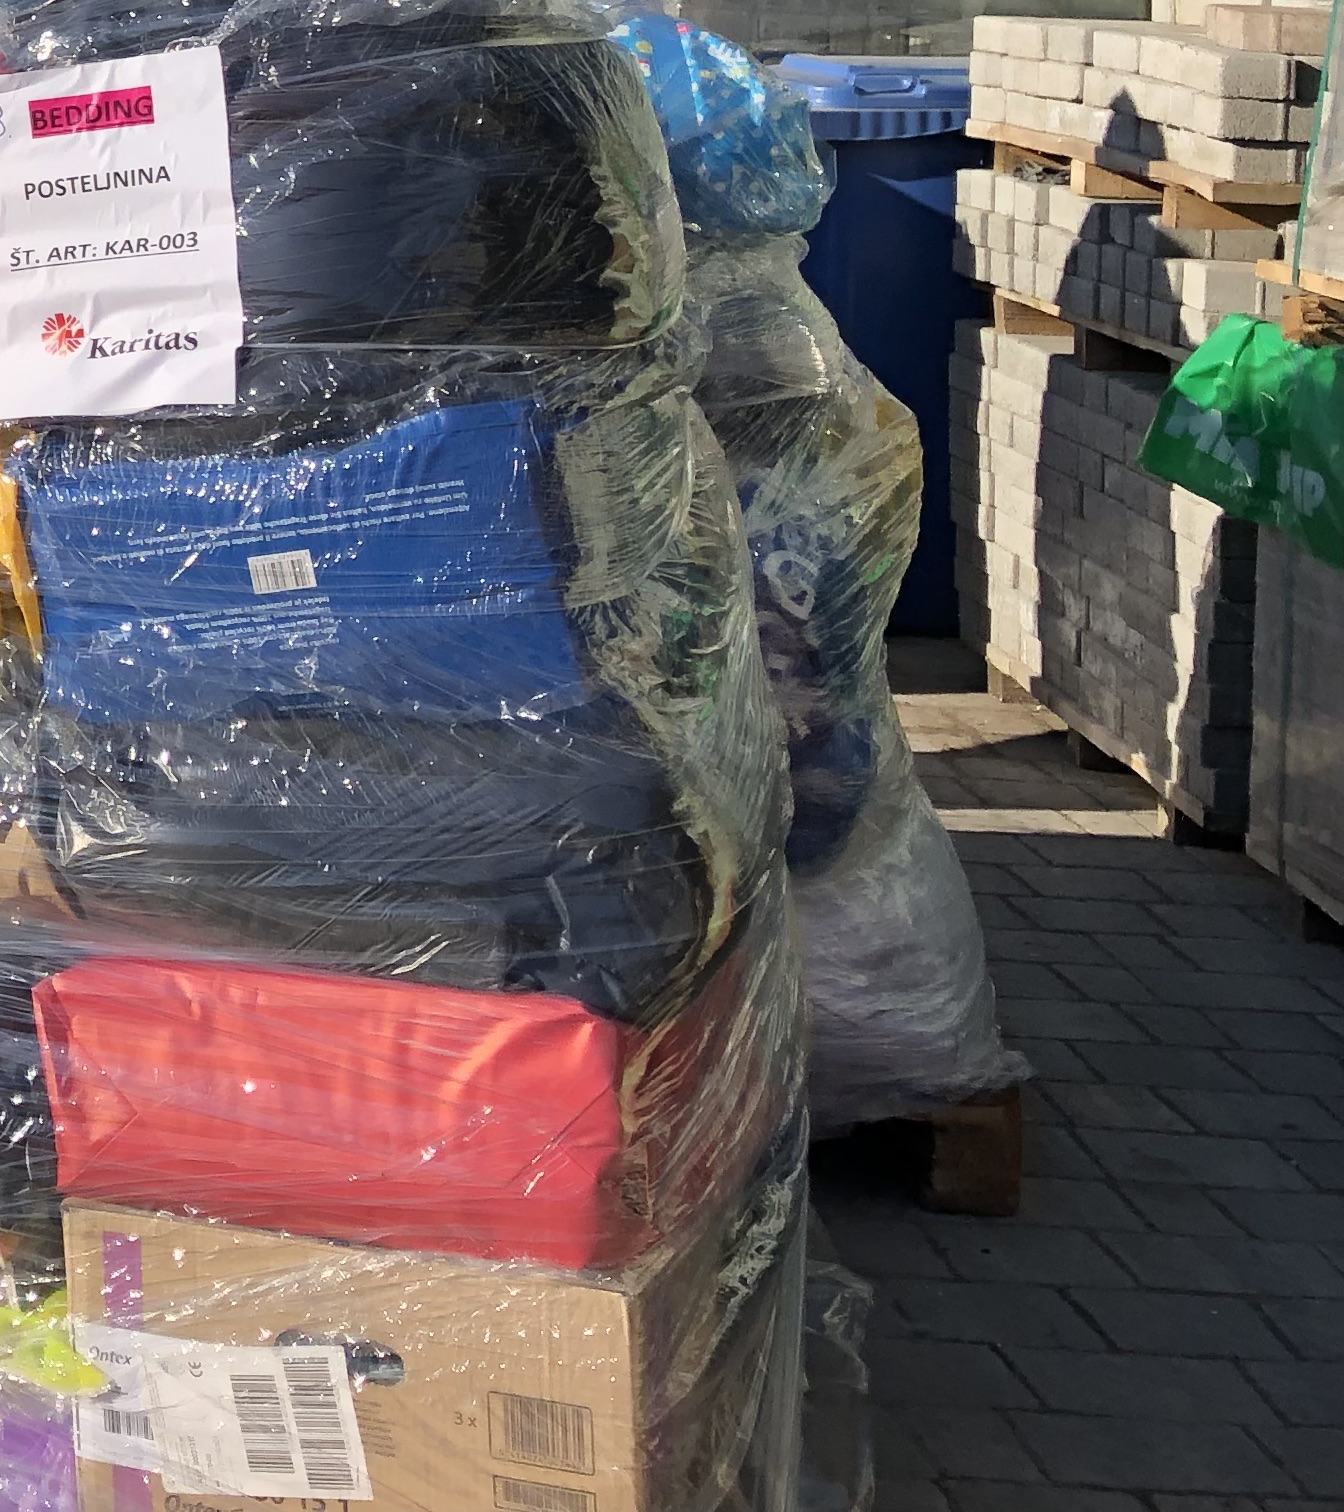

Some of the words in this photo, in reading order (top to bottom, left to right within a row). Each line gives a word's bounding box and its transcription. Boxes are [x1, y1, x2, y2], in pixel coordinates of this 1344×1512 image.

[31, 94, 153, 134] BEDDING
[24, 165, 172, 201] POSTELJNINA
[10, 247, 40, 268] ŠT.
[47, 241, 98, 262] ART:
[106, 230, 200, 257] KAR-003
[87, 326, 199, 360] Karitas
[89, 1345, 133, 1366] Ontex
[454, 1410, 464, 1426] 3
[467, 1415, 478, 1428] x
